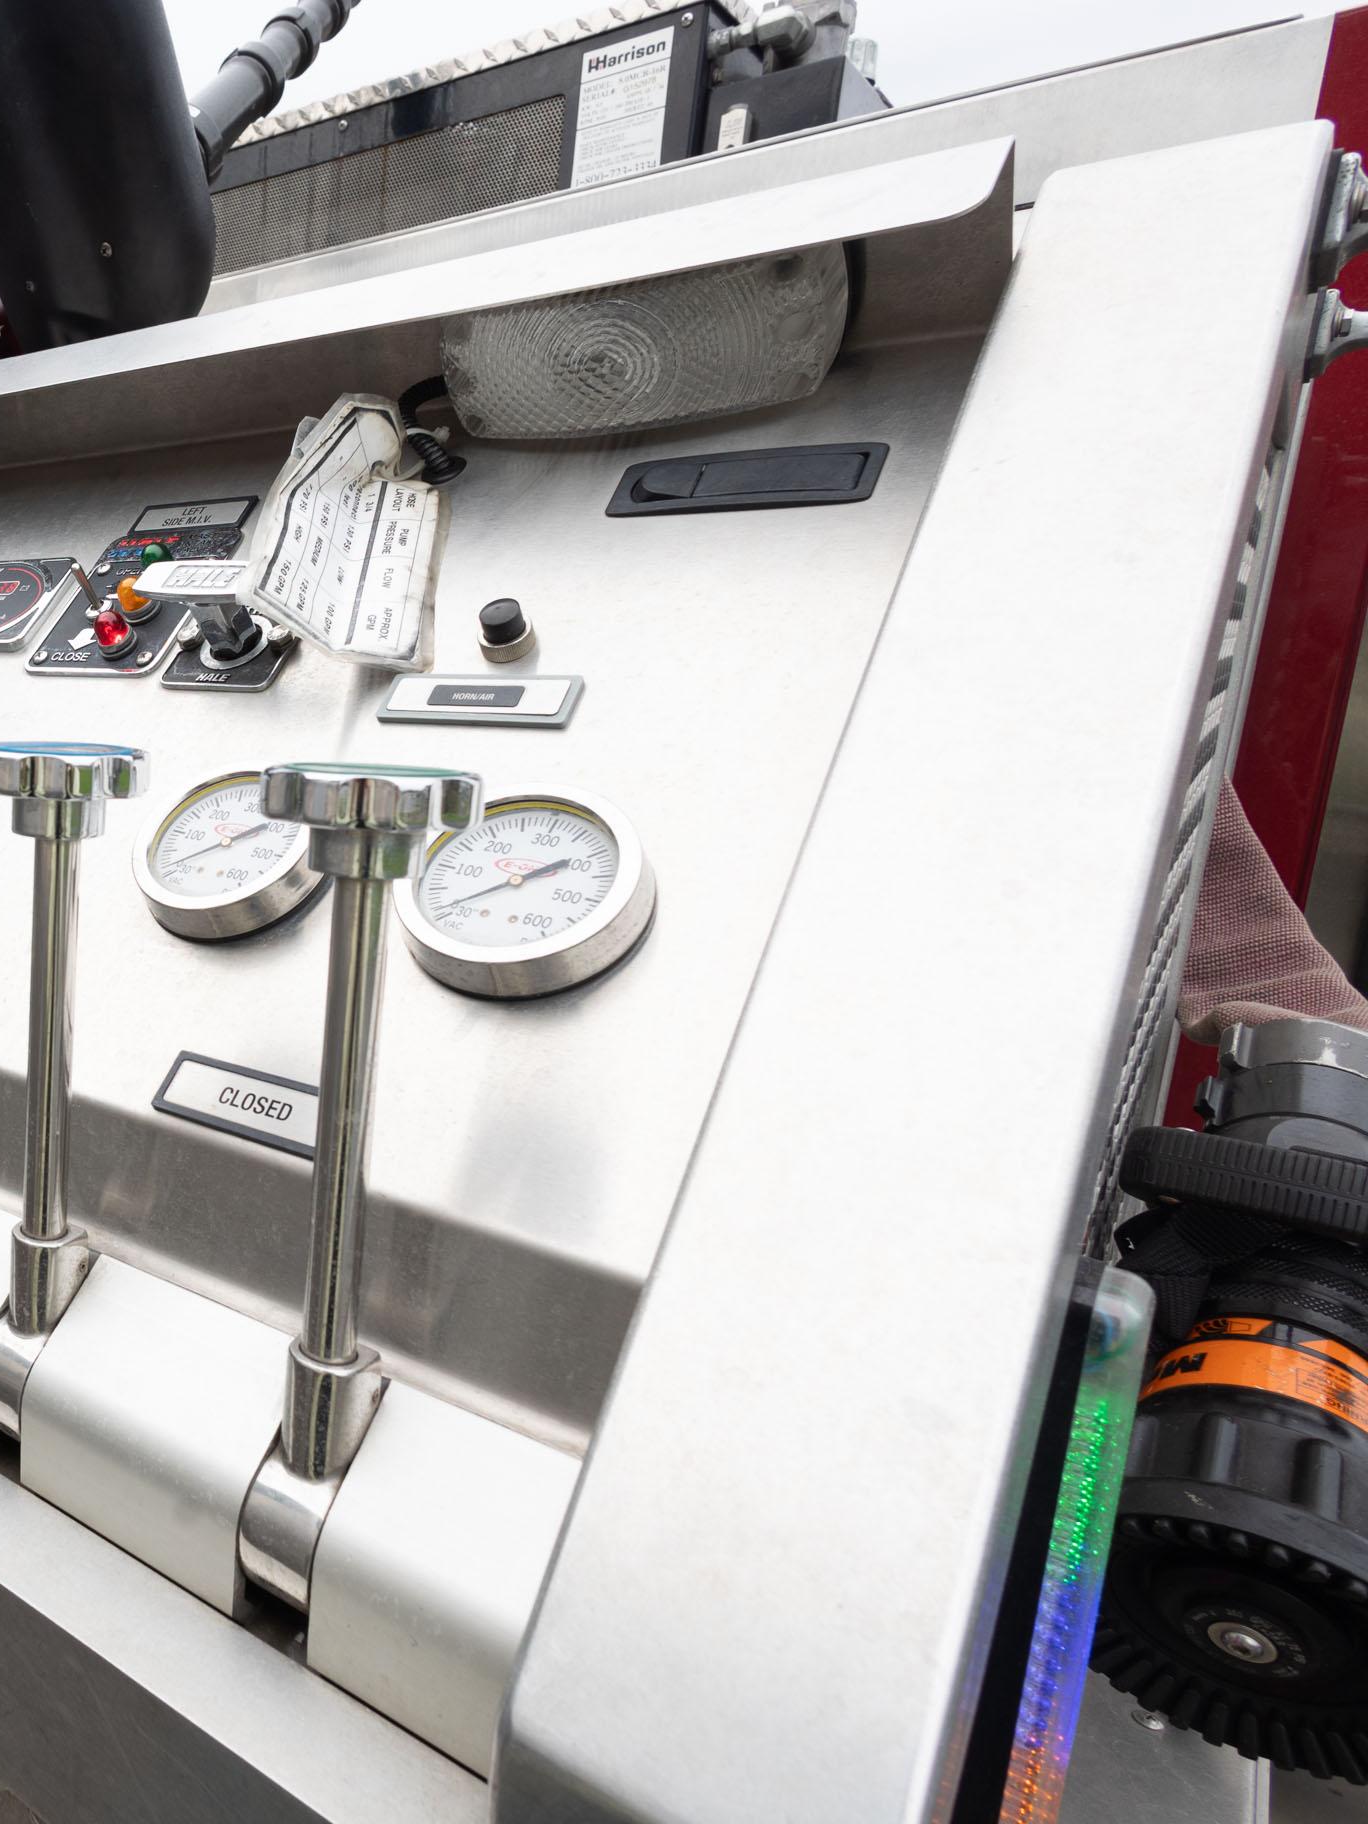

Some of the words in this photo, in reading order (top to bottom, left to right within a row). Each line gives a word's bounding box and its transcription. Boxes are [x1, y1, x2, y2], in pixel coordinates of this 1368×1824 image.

[588, 41, 666, 73] Harrison
[392, 488, 405, 512] LAYOUT
[406, 492, 417, 508] HOSE
[182, 506, 207, 516] LEFT
[162, 518, 185, 527] SIDE
[186, 514, 212, 525] M.I.V.
[381, 521, 397, 555] PRESSURE
[398, 528, 410, 547] PUMP
[310, 535, 324, 567] MEDIUM
[280, 559, 292, 576] 150
[164, 565, 244, 588] HALE
[381, 567, 394, 589] FLOW
[273, 575, 286, 595] GPM
[299, 578, 309, 594] 125
[296, 592, 306, 611] GPM
[366, 614, 377, 630] GPM
[50, 651, 91, 662] CLOSE
[195, 672, 231, 682] HALE
[452, 692, 495, 700] HORN/AIR
[208, 810, 231, 821] 200
[184, 830, 206, 841] 100
[531, 833, 560, 847] 300
[250, 847, 274, 860] 500
[484, 841, 512, 854] 200
[226, 869, 249, 881] 600
[455, 863, 483, 878] 100
[551, 888, 583, 905] 500
[443, 919, 464, 931] VAC
[522, 913, 553, 929] 600
[218, 1086, 293, 1121] CLOSED
